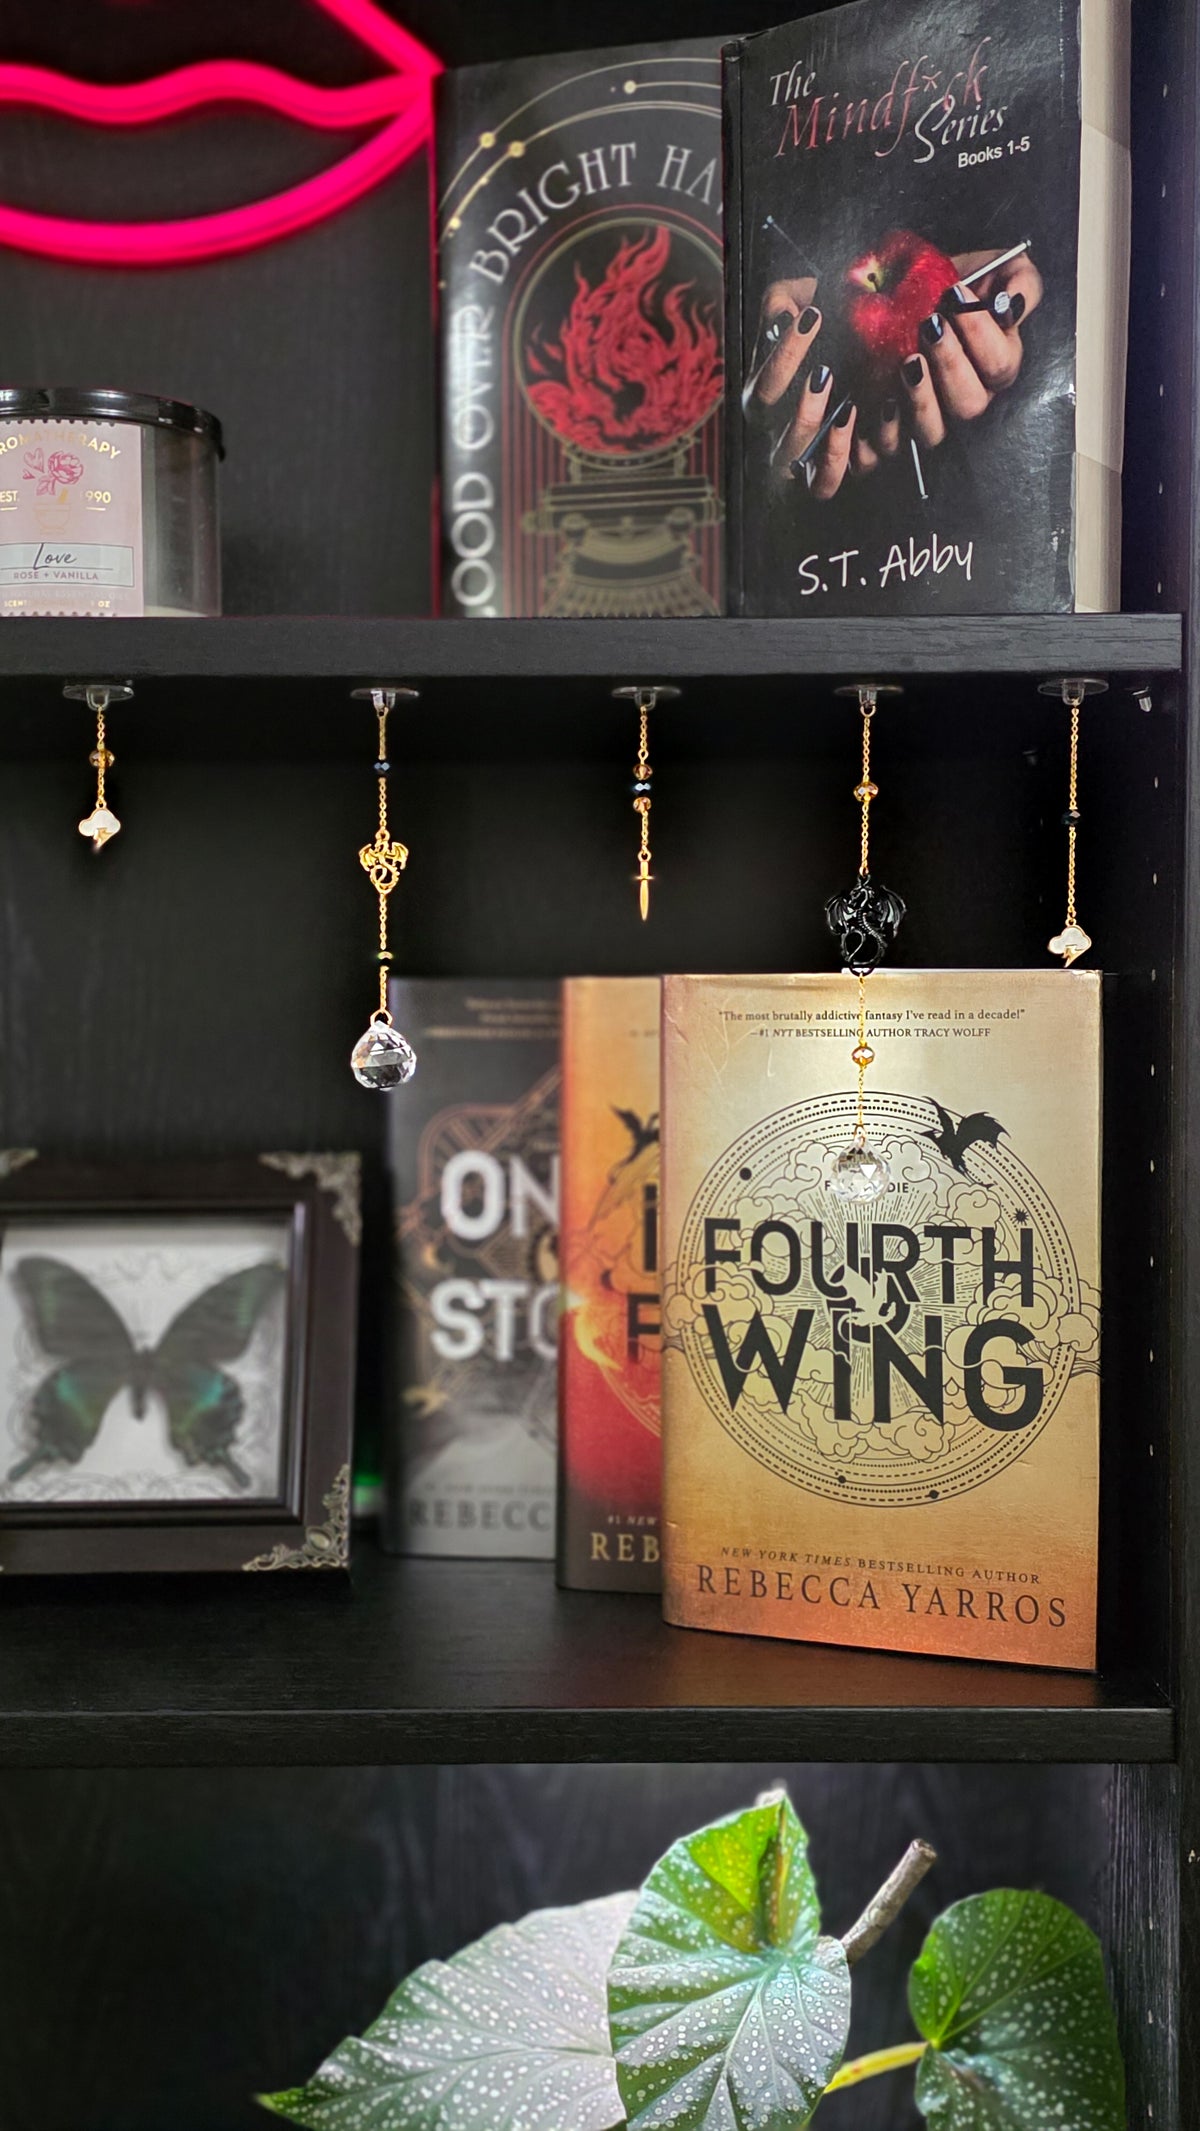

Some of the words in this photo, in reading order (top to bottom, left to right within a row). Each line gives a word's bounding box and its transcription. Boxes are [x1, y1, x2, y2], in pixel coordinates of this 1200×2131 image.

[770, 60, 816, 106] The
[913, 94, 1008, 164] Series
[957, 145, 1003, 168] Books
[1006, 136, 1031, 156] 1-5
[656, 145, 723, 215] HA
[469, 142, 637, 285] BRIGHT
[81, 490, 111, 503] 990
[32, 543, 78, 571] Love
[451, 472, 497, 618] OOD
[798, 550, 866, 595] S.T.
[879, 533, 973, 588] Abby
[13, 571, 39, 580] ROSE
[53, 571, 99, 581] VANILLA
[745, 1011, 770, 1021] most
[772, 1010, 813, 1023] brutally
[865, 1010, 903, 1022] fantasy
[906, 1010, 925, 1020] I've
[927, 1010, 951, 1020] read
[954, 1010, 966, 1020] in
[968, 1012, 975, 1020] a
[977, 1009, 1026, 1020] decade!"
[772, 1028, 794, 1038] NYT
[795, 1028, 864, 1038] BESTSELLING
[866, 1028, 912, 1037] AUTHOR
[914, 1028, 950, 1037] TRACY
[952, 1028, 991, 1037] WOLFF
[440, 1149, 560, 1241] ON
[887, 1182, 909, 1193] DIE
[704, 1217, 1034, 1308] FOURTH
[701, 1303, 1045, 1433] WING
[590, 1532, 660, 1563] REB
[721, 1547, 751, 1557] NEW
[759, 1550, 799, 1562] YORK
[804, 1554, 851, 1567] TIMES
[858, 1558, 964, 1577] BESTSELLING
[973, 1569, 1040, 1584] AUTHOR
[697, 1565, 881, 1610] REBECCA
[902, 1583, 1066, 1628] YARROS
